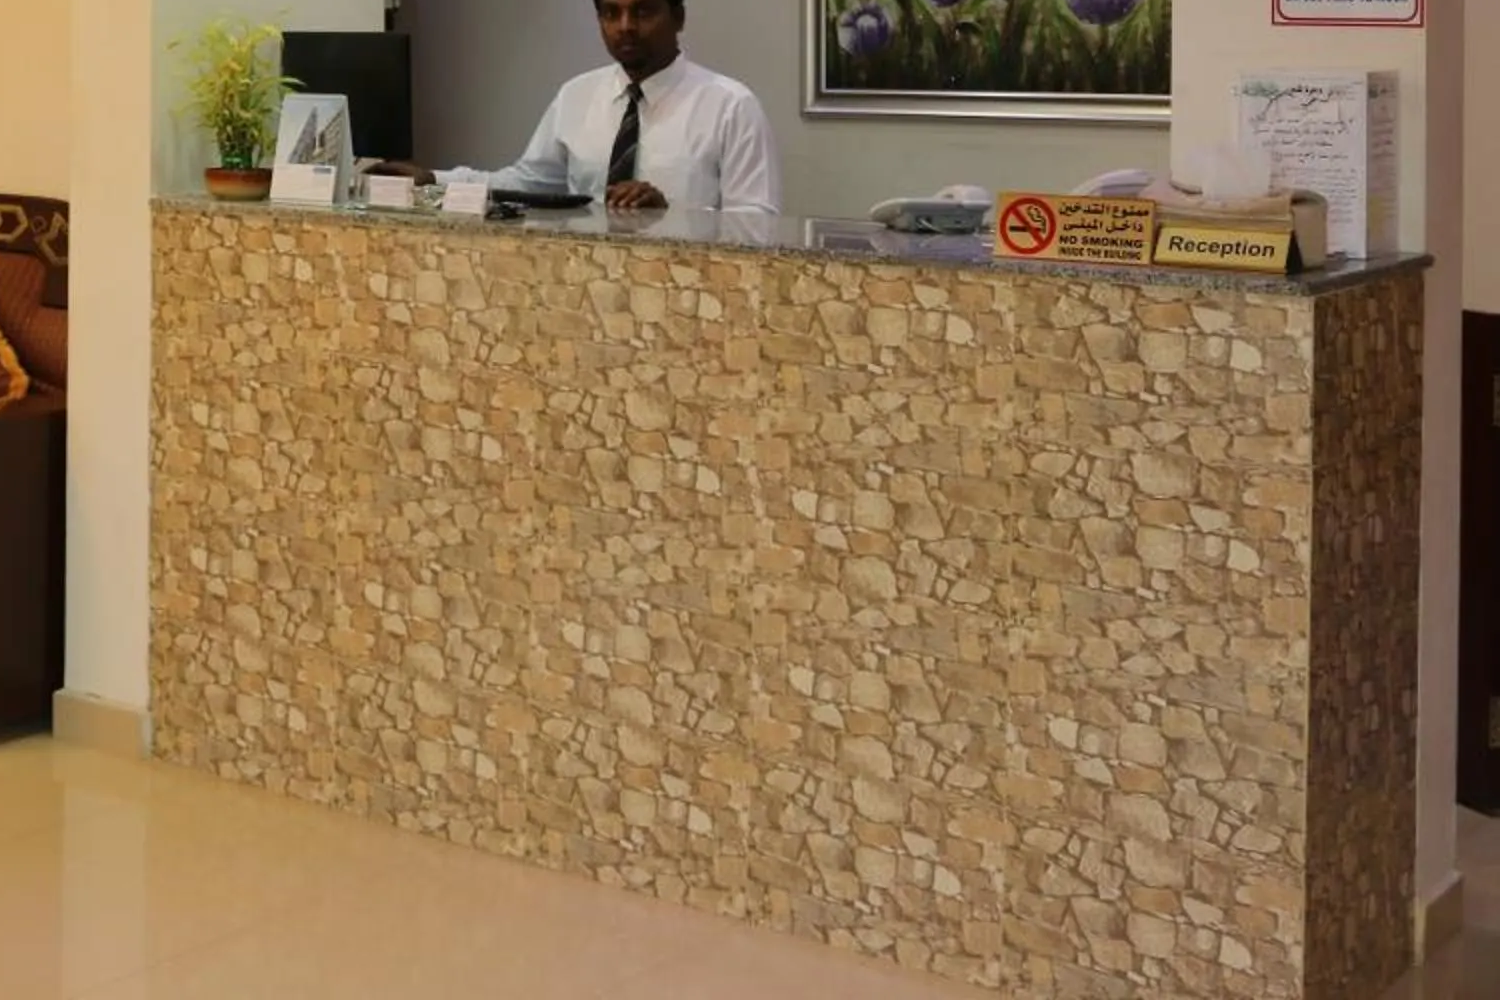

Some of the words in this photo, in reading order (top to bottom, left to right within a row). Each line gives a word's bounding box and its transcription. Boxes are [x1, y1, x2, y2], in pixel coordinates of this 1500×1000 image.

[1059, 202, 1110, 216] التدخين
[1111, 205, 1149, 218] ممنوع
[1105, 219, 1143, 233] داخل
[1059, 235, 1078, 245] NO
[1081, 236, 1143, 248] SMOKING
[1168, 235, 1276, 259] Reception
[1058, 246, 1085, 257] INSIDE
[1087, 248, 1102, 257] THE
[1104, 249, 1142, 260] BUILDING
